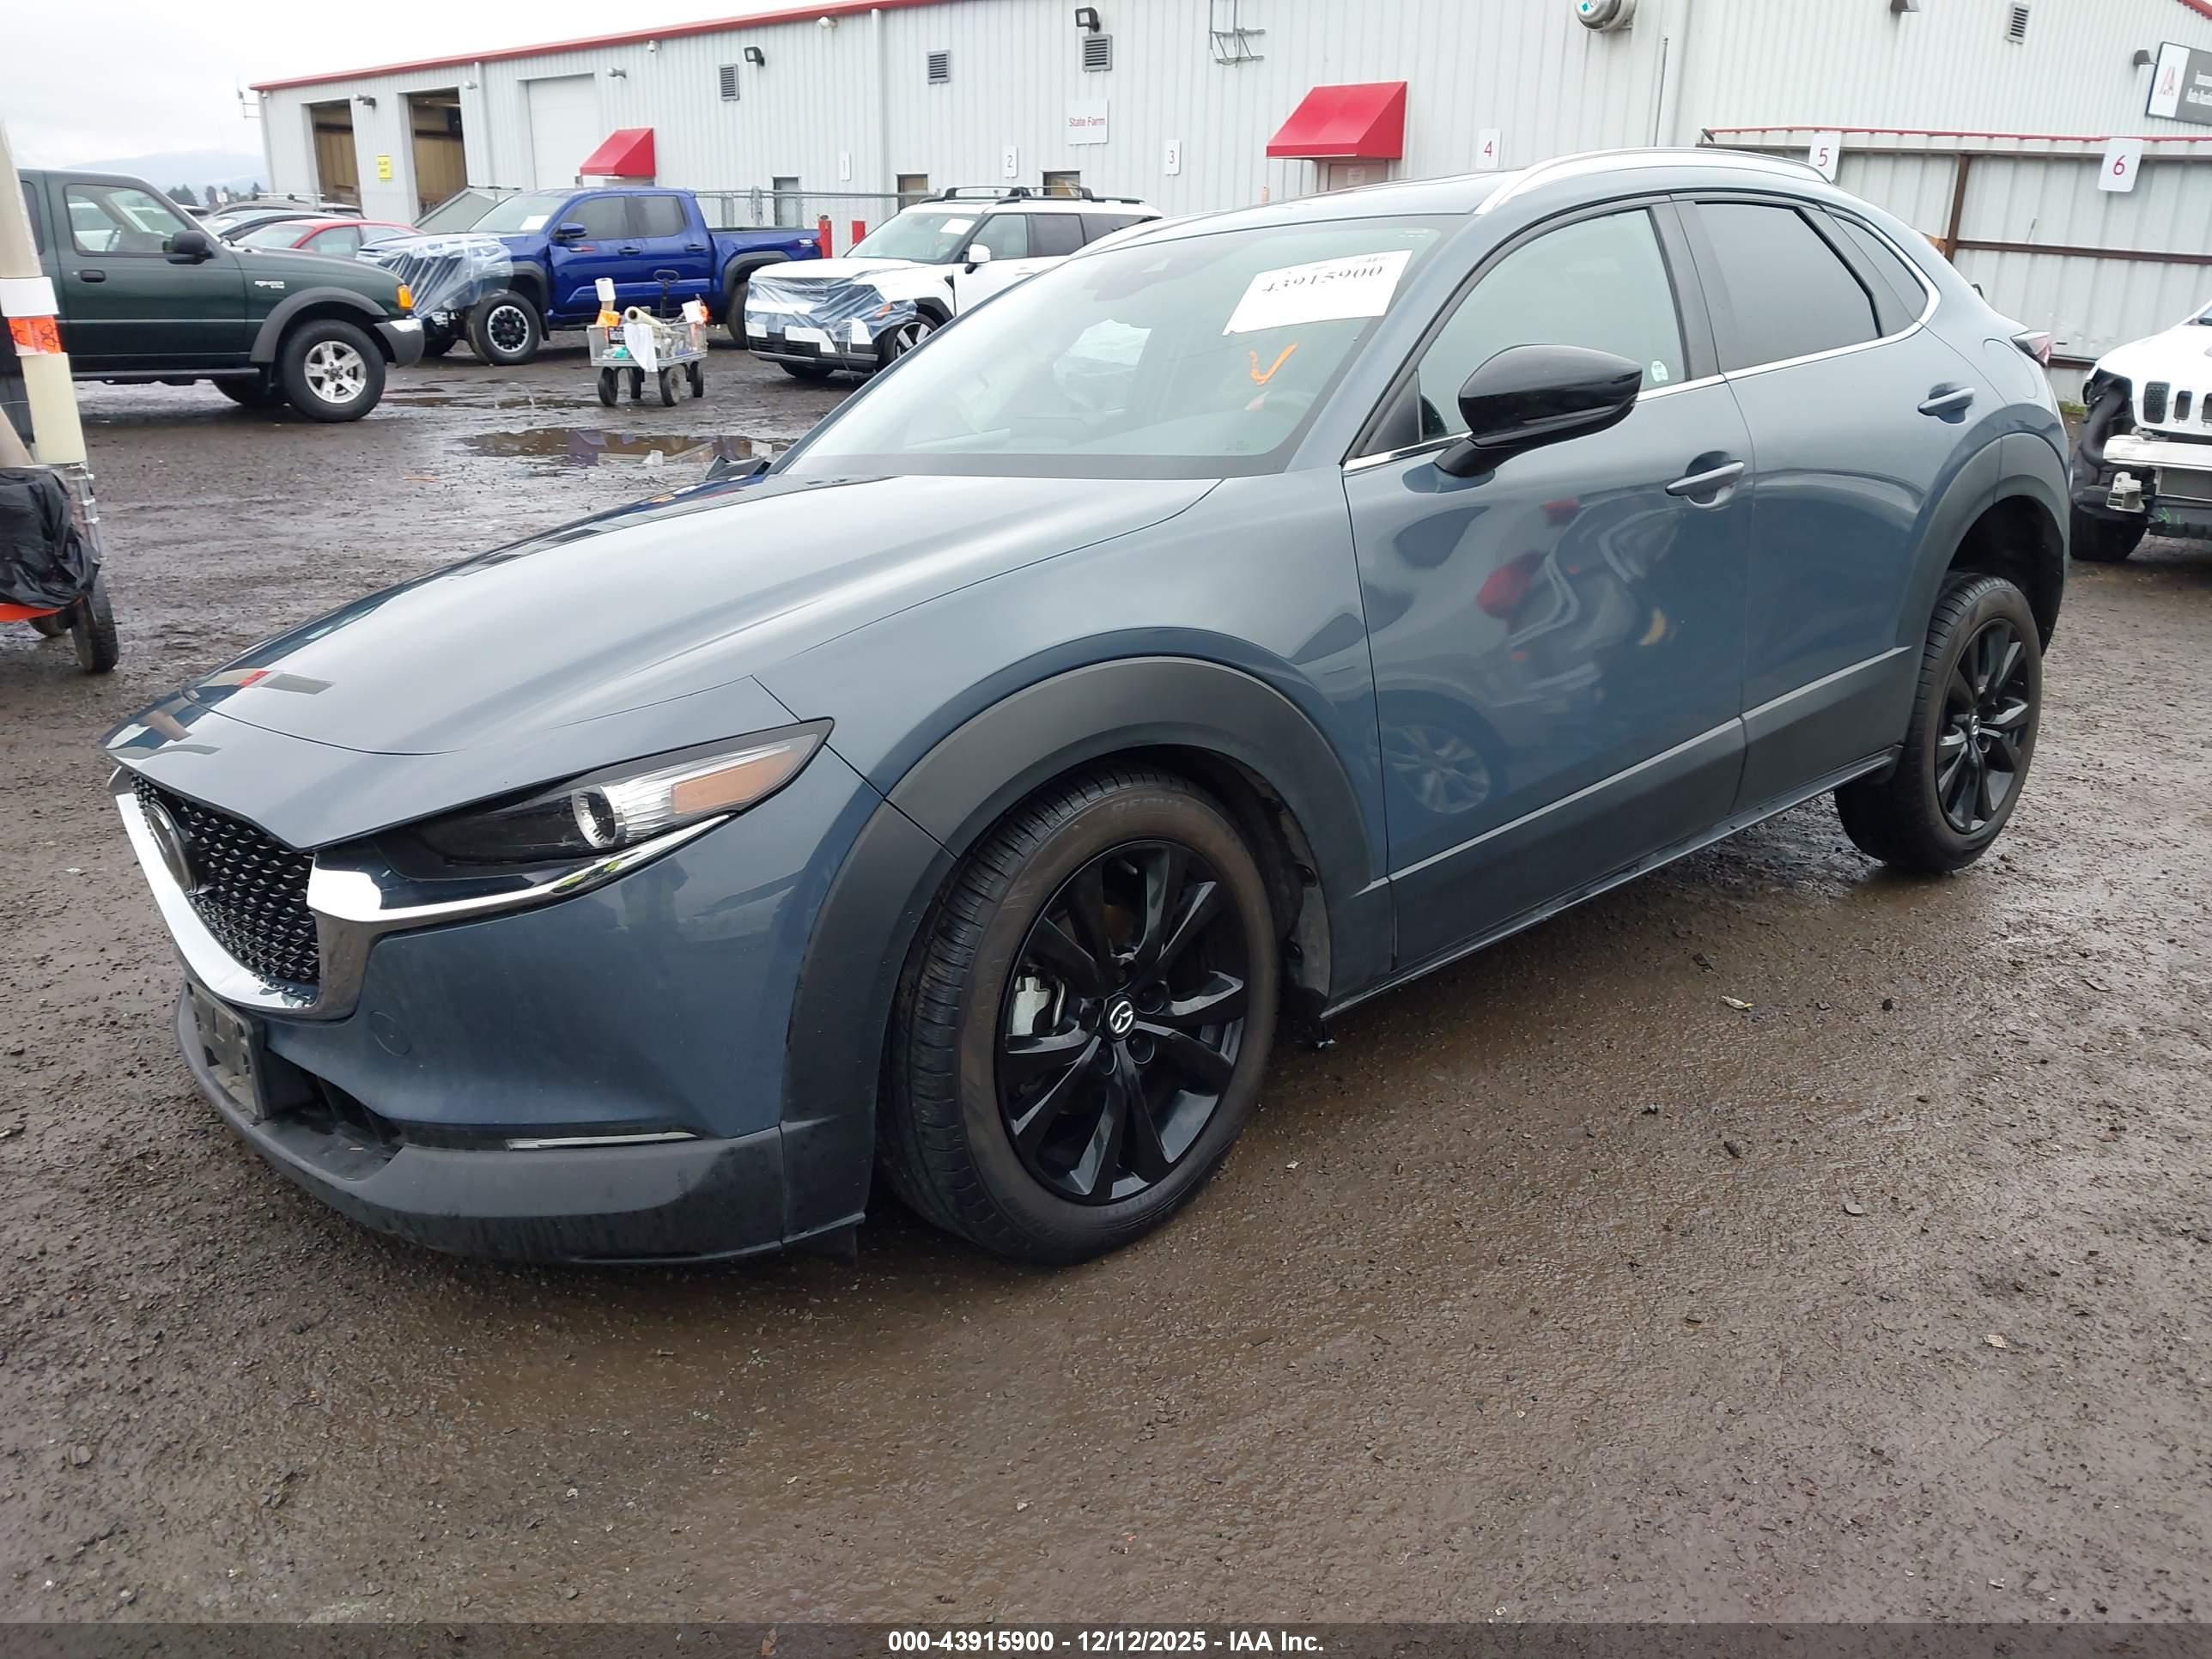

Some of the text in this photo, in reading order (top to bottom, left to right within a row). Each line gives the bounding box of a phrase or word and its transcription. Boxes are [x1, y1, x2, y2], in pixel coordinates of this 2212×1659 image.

[1069, 117, 1105, 127] State Farm
[1169, 149, 1175, 164] 3
[1484, 140, 1492, 157] 4
[1007, 155, 1013, 168] 2
[1818, 148, 1828, 167] 5
[2113, 155, 2125, 175] 6
